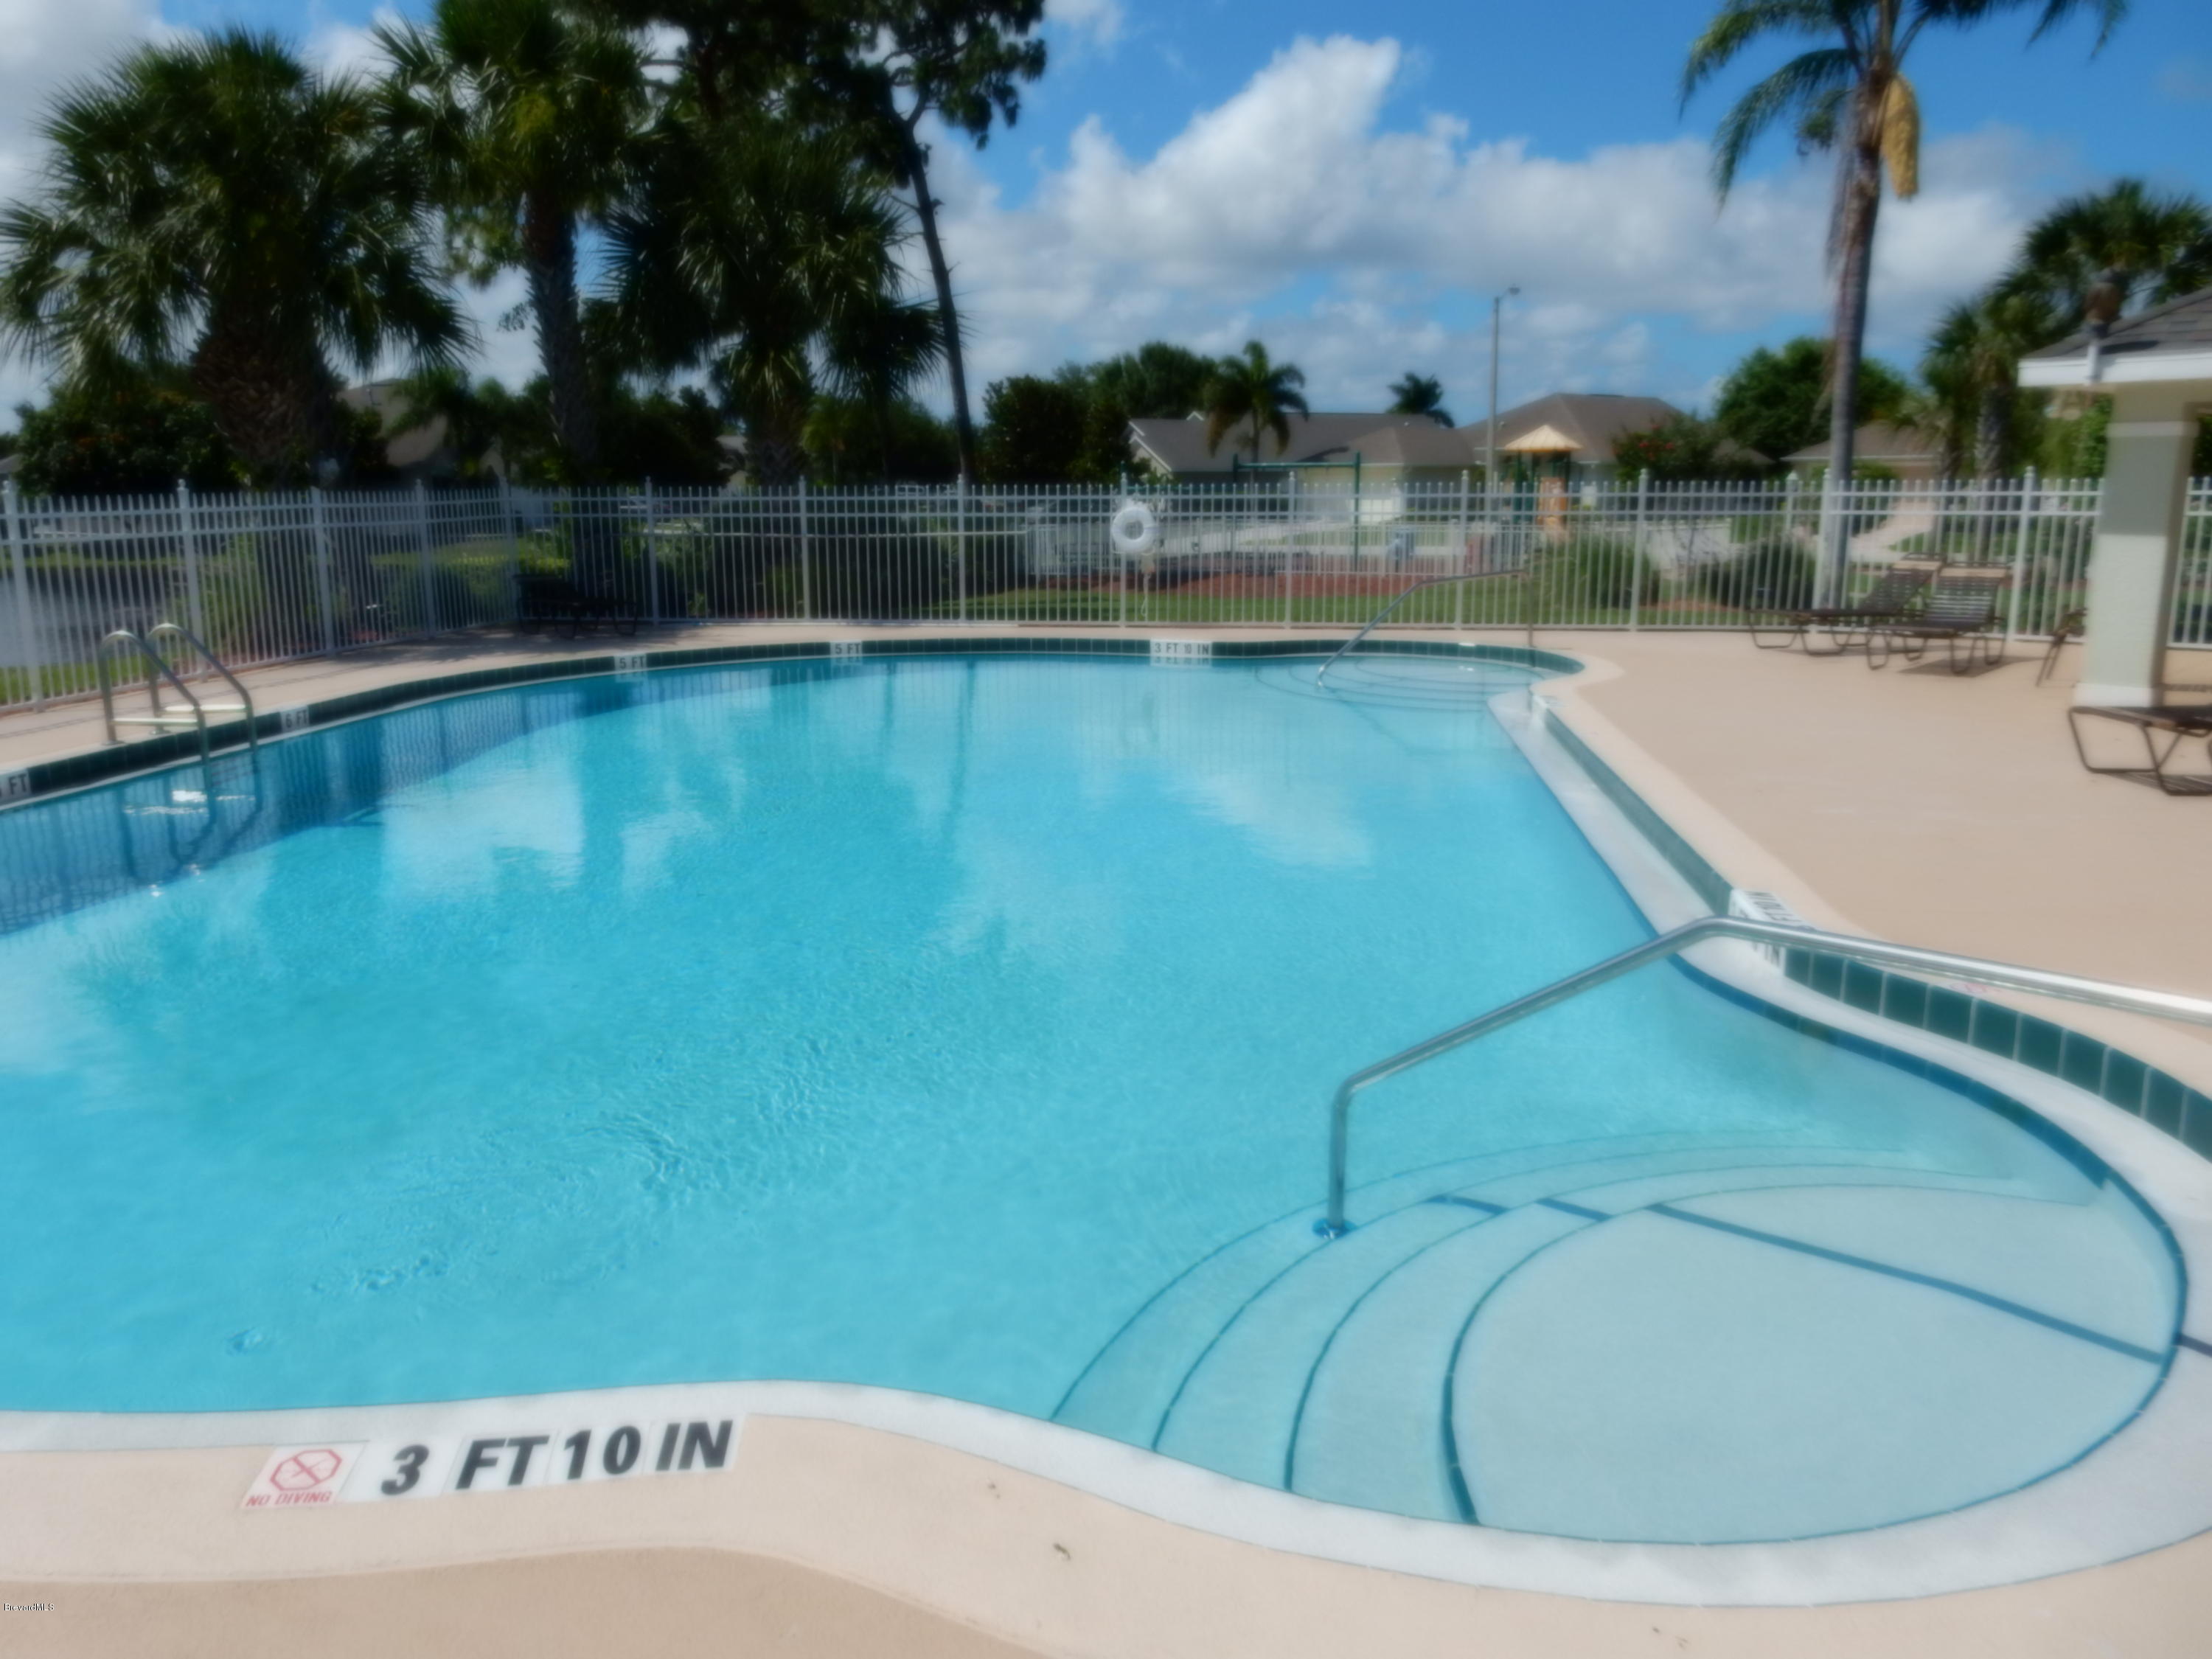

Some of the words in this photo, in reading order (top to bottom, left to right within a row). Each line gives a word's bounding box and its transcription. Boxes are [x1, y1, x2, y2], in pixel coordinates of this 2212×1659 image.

[835, 643, 843, 655] 5
[846, 643, 861, 655] FT
[1155, 643, 1161, 653] 3
[1166, 643, 1178, 653] FT
[1183, 643, 1192, 653] 10
[1197, 644, 1209, 655] IN
[619, 657, 626, 669] 5
[631, 655, 645, 669] FT
[285, 713, 293, 728] 6
[296, 709, 307, 726] FT
[9, 773, 27, 797] FT
[380, 1444, 429, 1496] 3
[456, 1435, 550, 1490] FT
[564, 1425, 641, 1481] 10
[655, 1420, 734, 1472] IN
[246, 1495, 271, 1507] NO
[275, 1491, 332, 1505] DIVING
